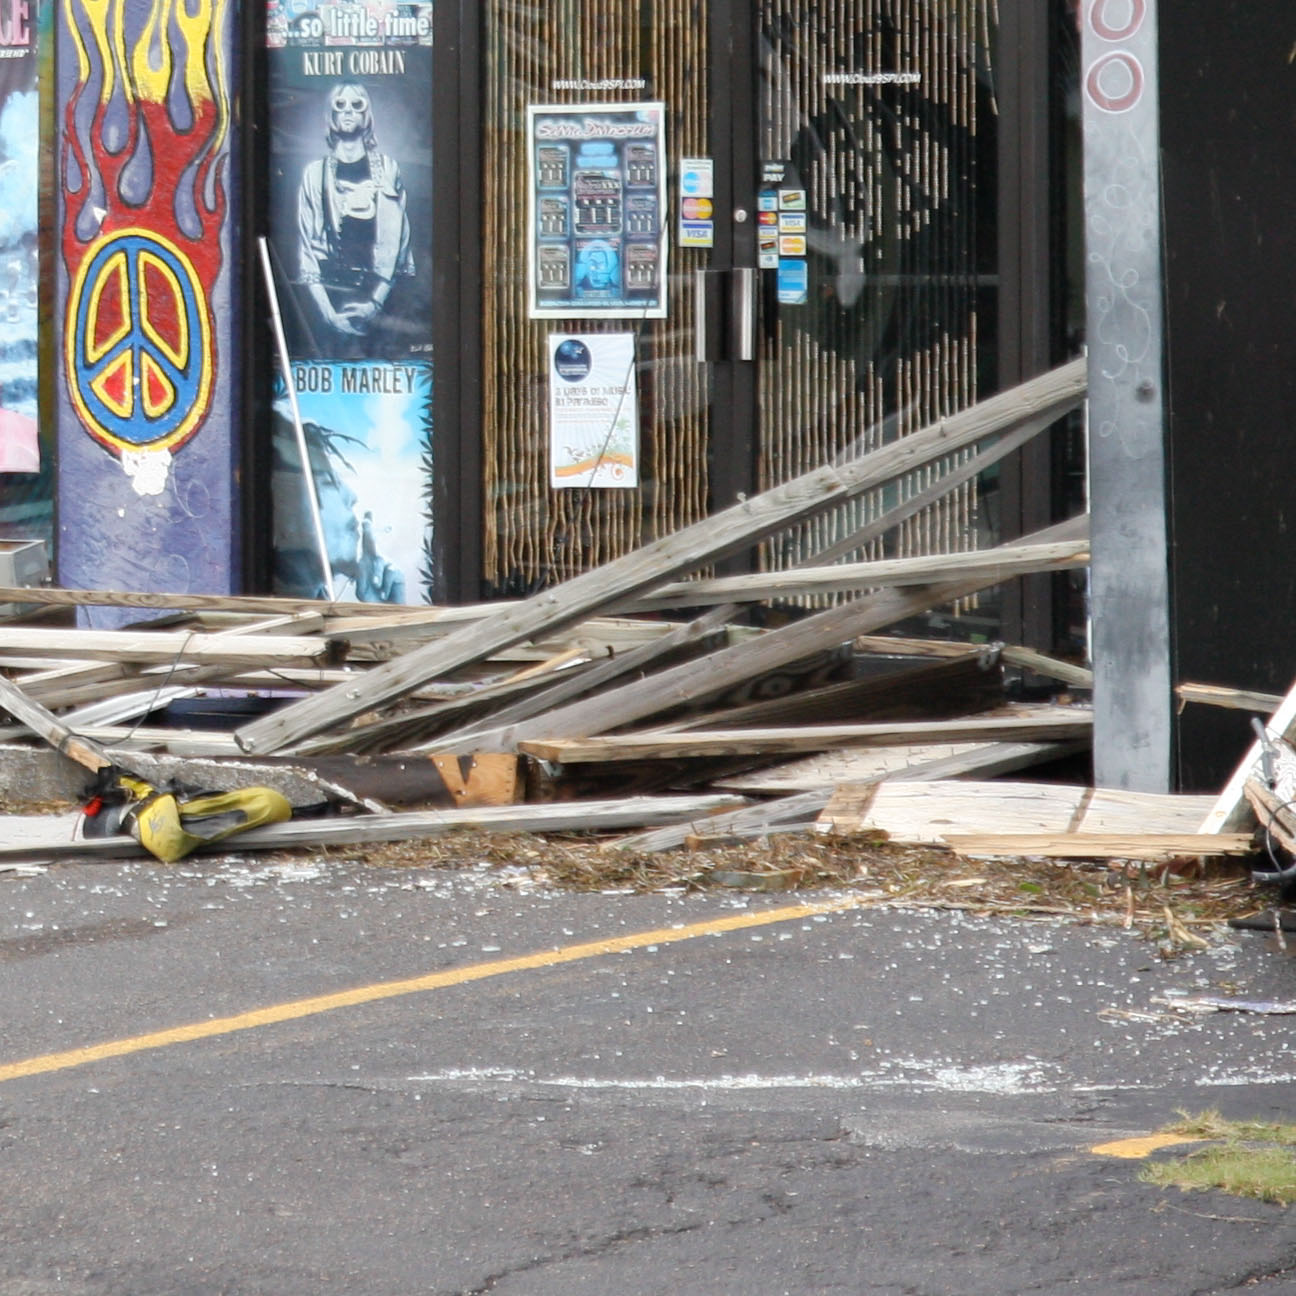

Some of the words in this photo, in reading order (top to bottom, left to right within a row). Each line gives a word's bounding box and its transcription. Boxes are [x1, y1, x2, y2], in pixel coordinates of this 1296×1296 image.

[331, 6, 378, 37] little
[384, 10, 430, 37] time
[304, 51, 345, 76] KURT
[349, 50, 407, 75] COBAIN
[295, 368, 332, 394] BOB
[341, 367, 418, 394] MARLEY
